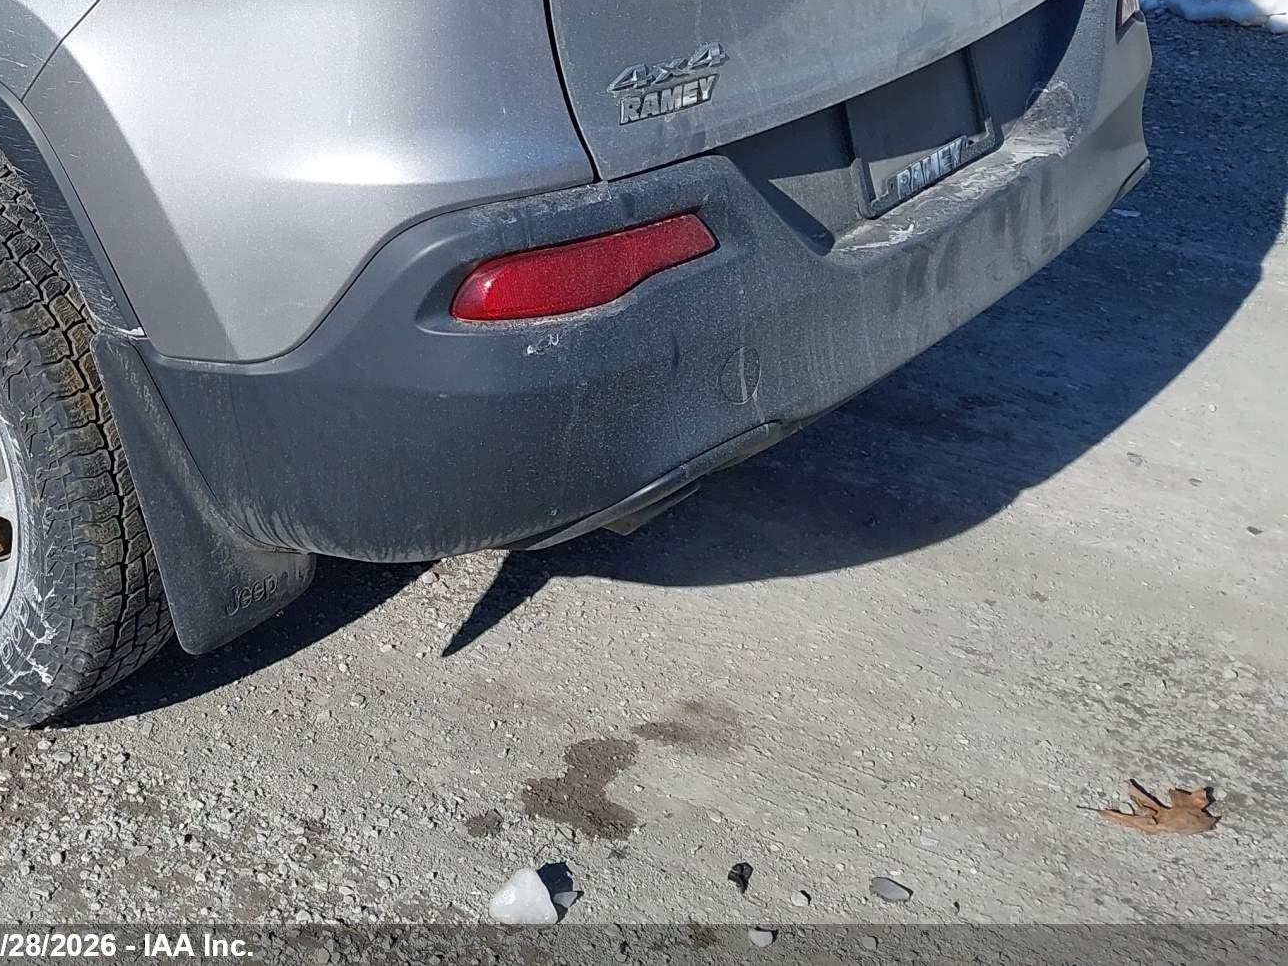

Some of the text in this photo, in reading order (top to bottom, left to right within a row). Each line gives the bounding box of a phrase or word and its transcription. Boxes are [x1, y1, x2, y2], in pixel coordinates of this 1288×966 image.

[619, 75, 717, 125] RAMEY
[896, 136, 964, 201] RAMEY
[226, 573, 278, 617] Jeep
